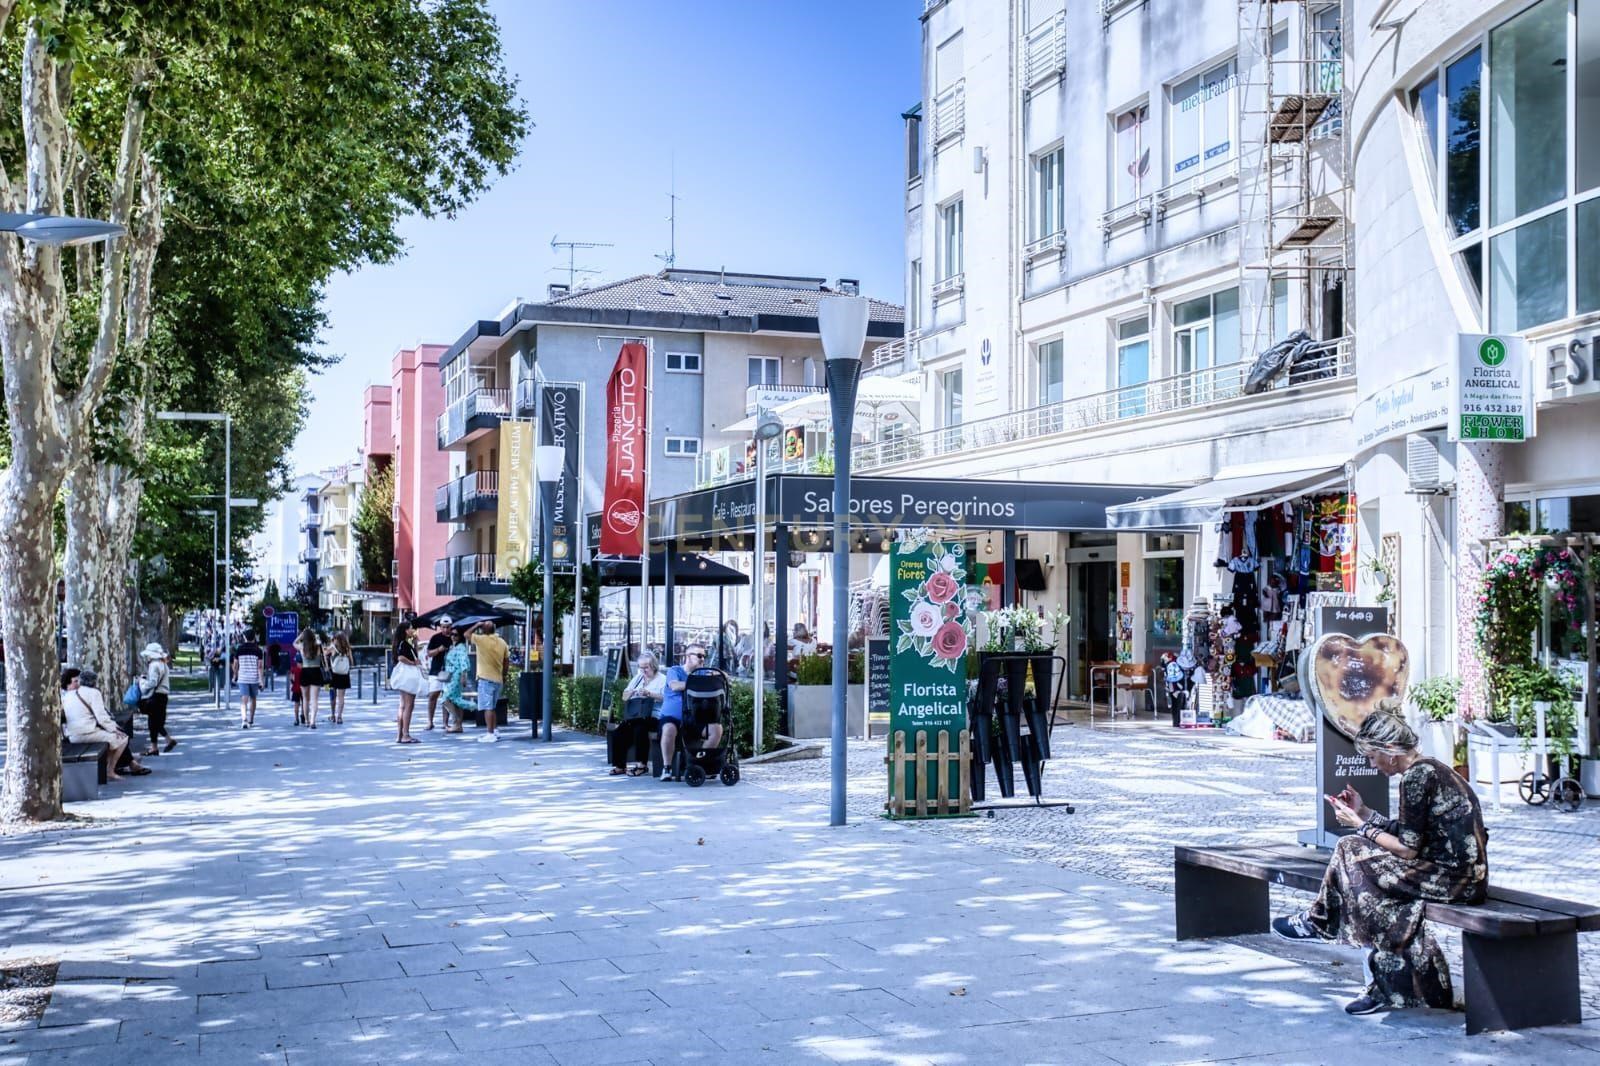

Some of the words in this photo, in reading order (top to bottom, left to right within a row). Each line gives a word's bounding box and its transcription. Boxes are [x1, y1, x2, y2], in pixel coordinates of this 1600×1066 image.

[1182, 74, 1247, 112] mediFatim
[1547, 336, 1600, 389] ES
[1473, 367, 1511, 378] Florista
[1465, 379, 1520, 389] ANGELICAL
[1464, 404, 1481, 412] 916
[1484, 404, 1502, 412] 432
[1505, 404, 1522, 413] 187
[553, 391, 566, 448] ERATIVO
[620, 367, 636, 483] JUANCITO
[1464, 416, 1521, 427] FLOWER
[1464, 427, 1521, 438] SHOP
[511, 425, 521, 471] MUSEUM
[712, 502, 726, 521] Café
[730, 501, 756, 518] Restaura
[803, 491, 894, 515] Saores
[900, 494, 1016, 522] Peregrinos
[903, 683, 957, 697] Florista
[898, 701, 962, 719] Angelical
[1335, 754, 1367, 765] Pastéis
[1335, 765, 1347, 776] de
[1348, 766, 1379, 776] Fátima
